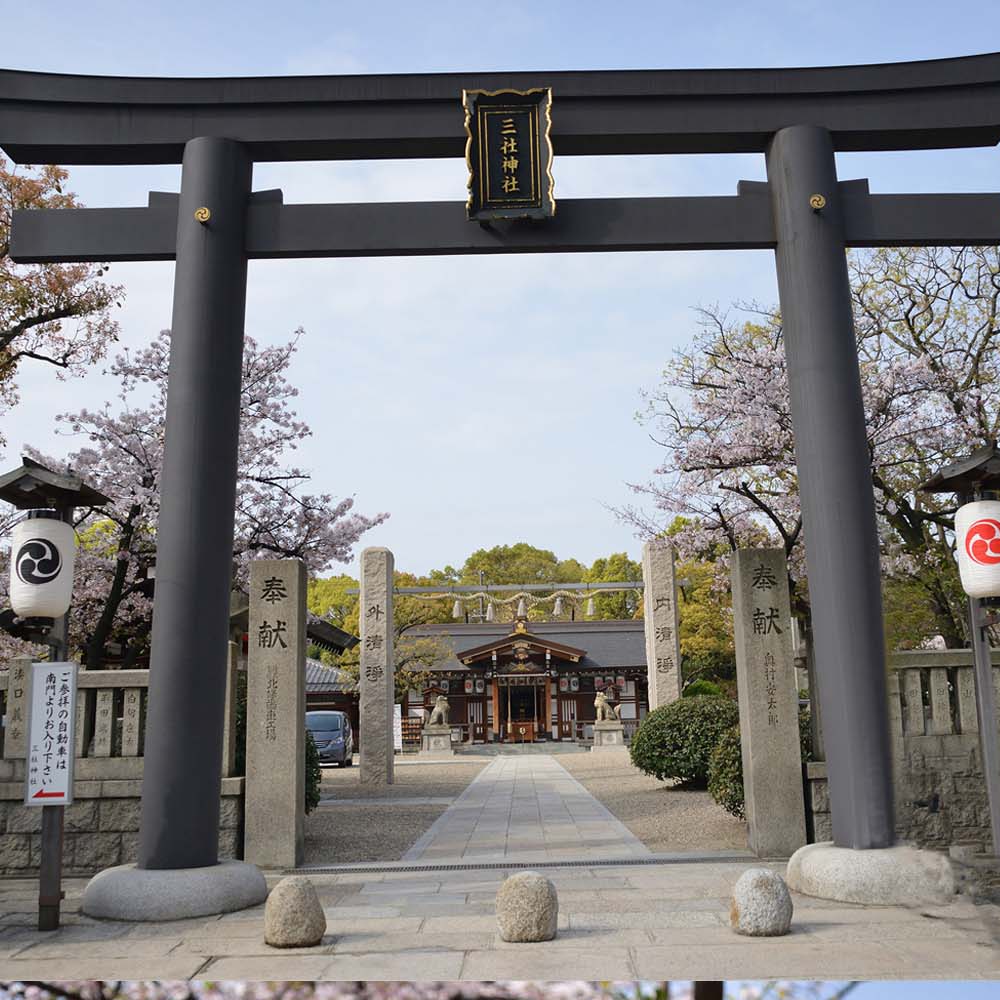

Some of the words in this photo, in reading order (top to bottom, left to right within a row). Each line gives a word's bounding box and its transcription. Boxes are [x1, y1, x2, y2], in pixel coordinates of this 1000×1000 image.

[499, 118, 521, 193] 三社神社
[258, 576, 288, 649] 奉献
[752, 563, 783, 636] 奉献
[42, 672, 57, 785] 南門よりお入り下さい
[56, 672, 71, 770] ご参拝の自動車は
